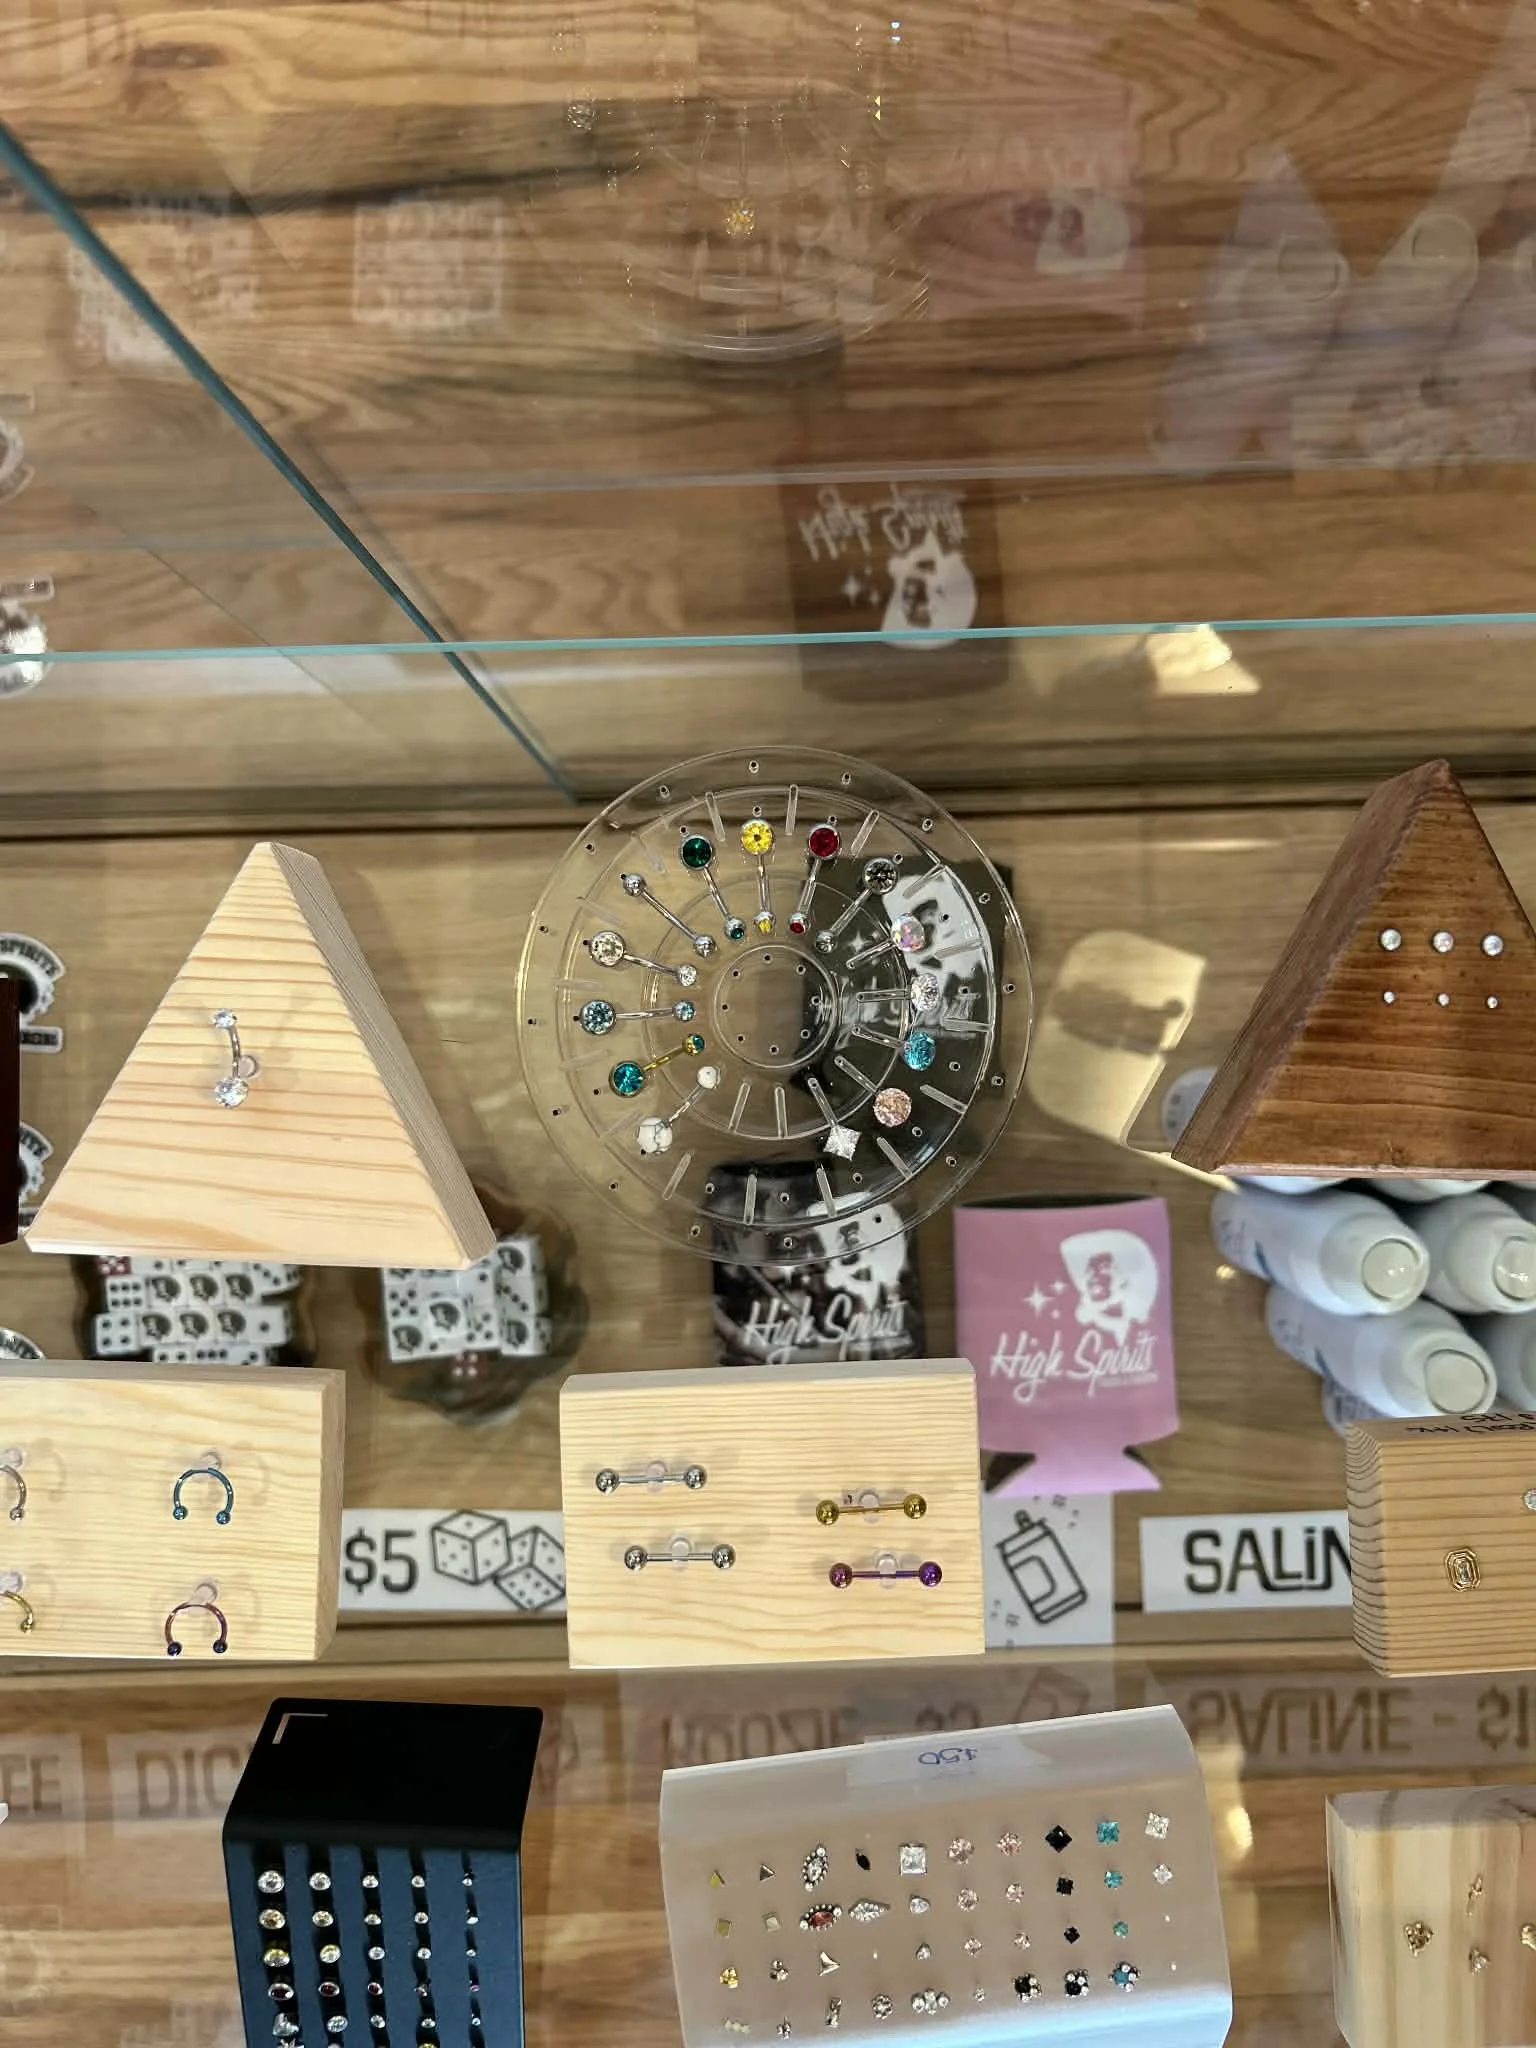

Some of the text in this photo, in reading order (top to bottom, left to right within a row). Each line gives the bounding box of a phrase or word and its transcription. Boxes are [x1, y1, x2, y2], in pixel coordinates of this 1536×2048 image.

[744, 1293, 907, 1364] High Spirits
[989, 1328, 1158, 1404] High Spirits
[344, 1527, 418, 1594] $5
